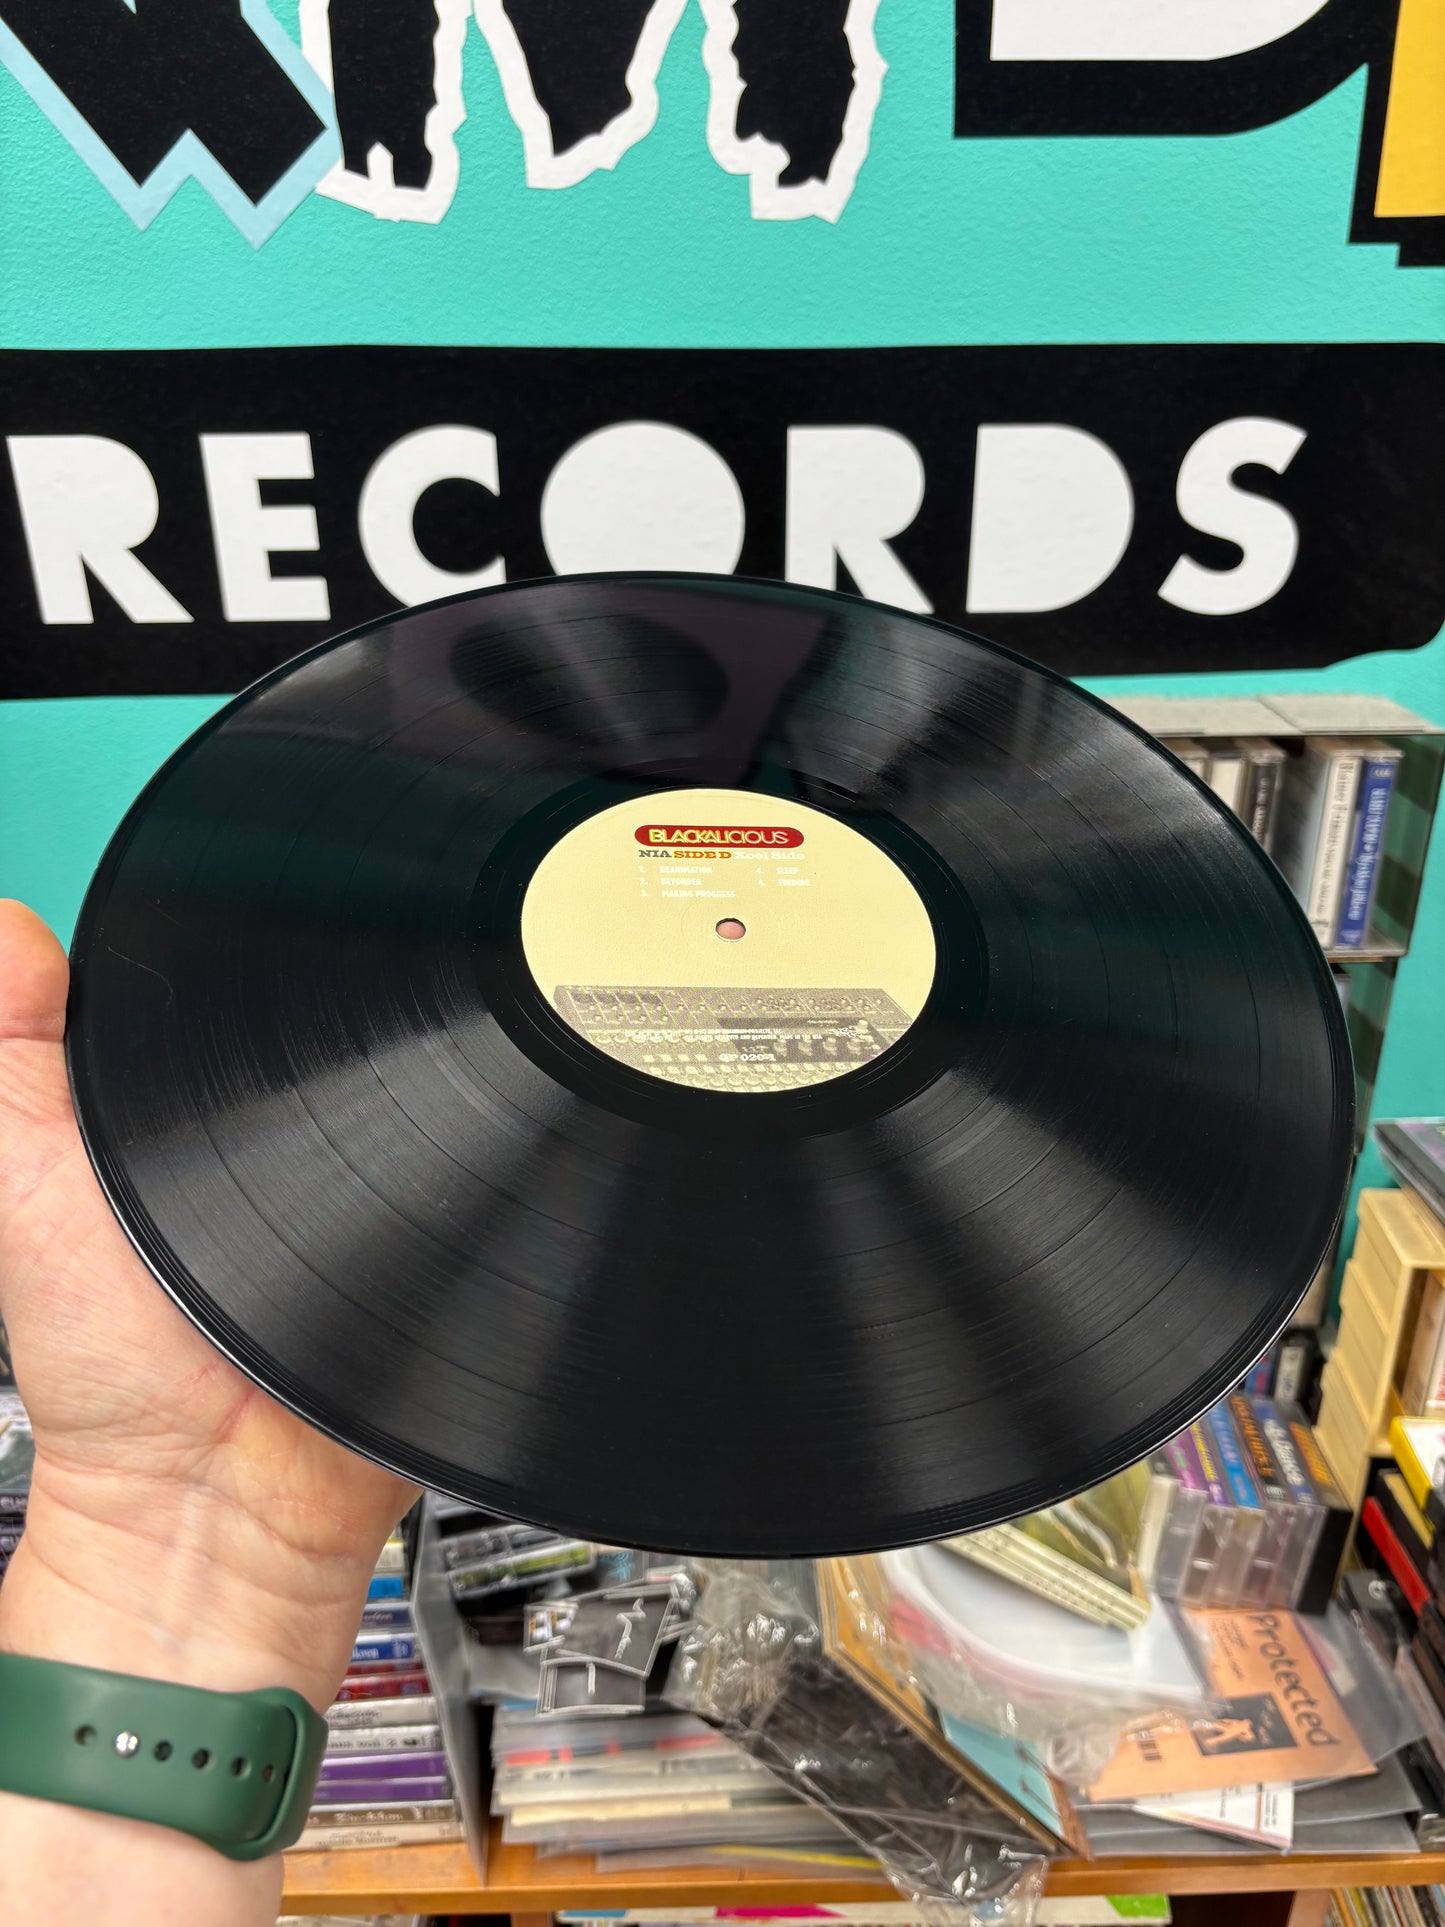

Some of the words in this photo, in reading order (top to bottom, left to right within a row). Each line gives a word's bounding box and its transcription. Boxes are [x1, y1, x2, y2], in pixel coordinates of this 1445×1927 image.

[6, 417, 1307, 624] RECORDS
[638, 849, 672, 858] NIA
[673, 850, 716, 859] SIDE
[718, 851, 732, 859] D
[648, 829, 790, 845] BLACKALICIOUS
[1249, 1613, 1343, 1747] Protected
